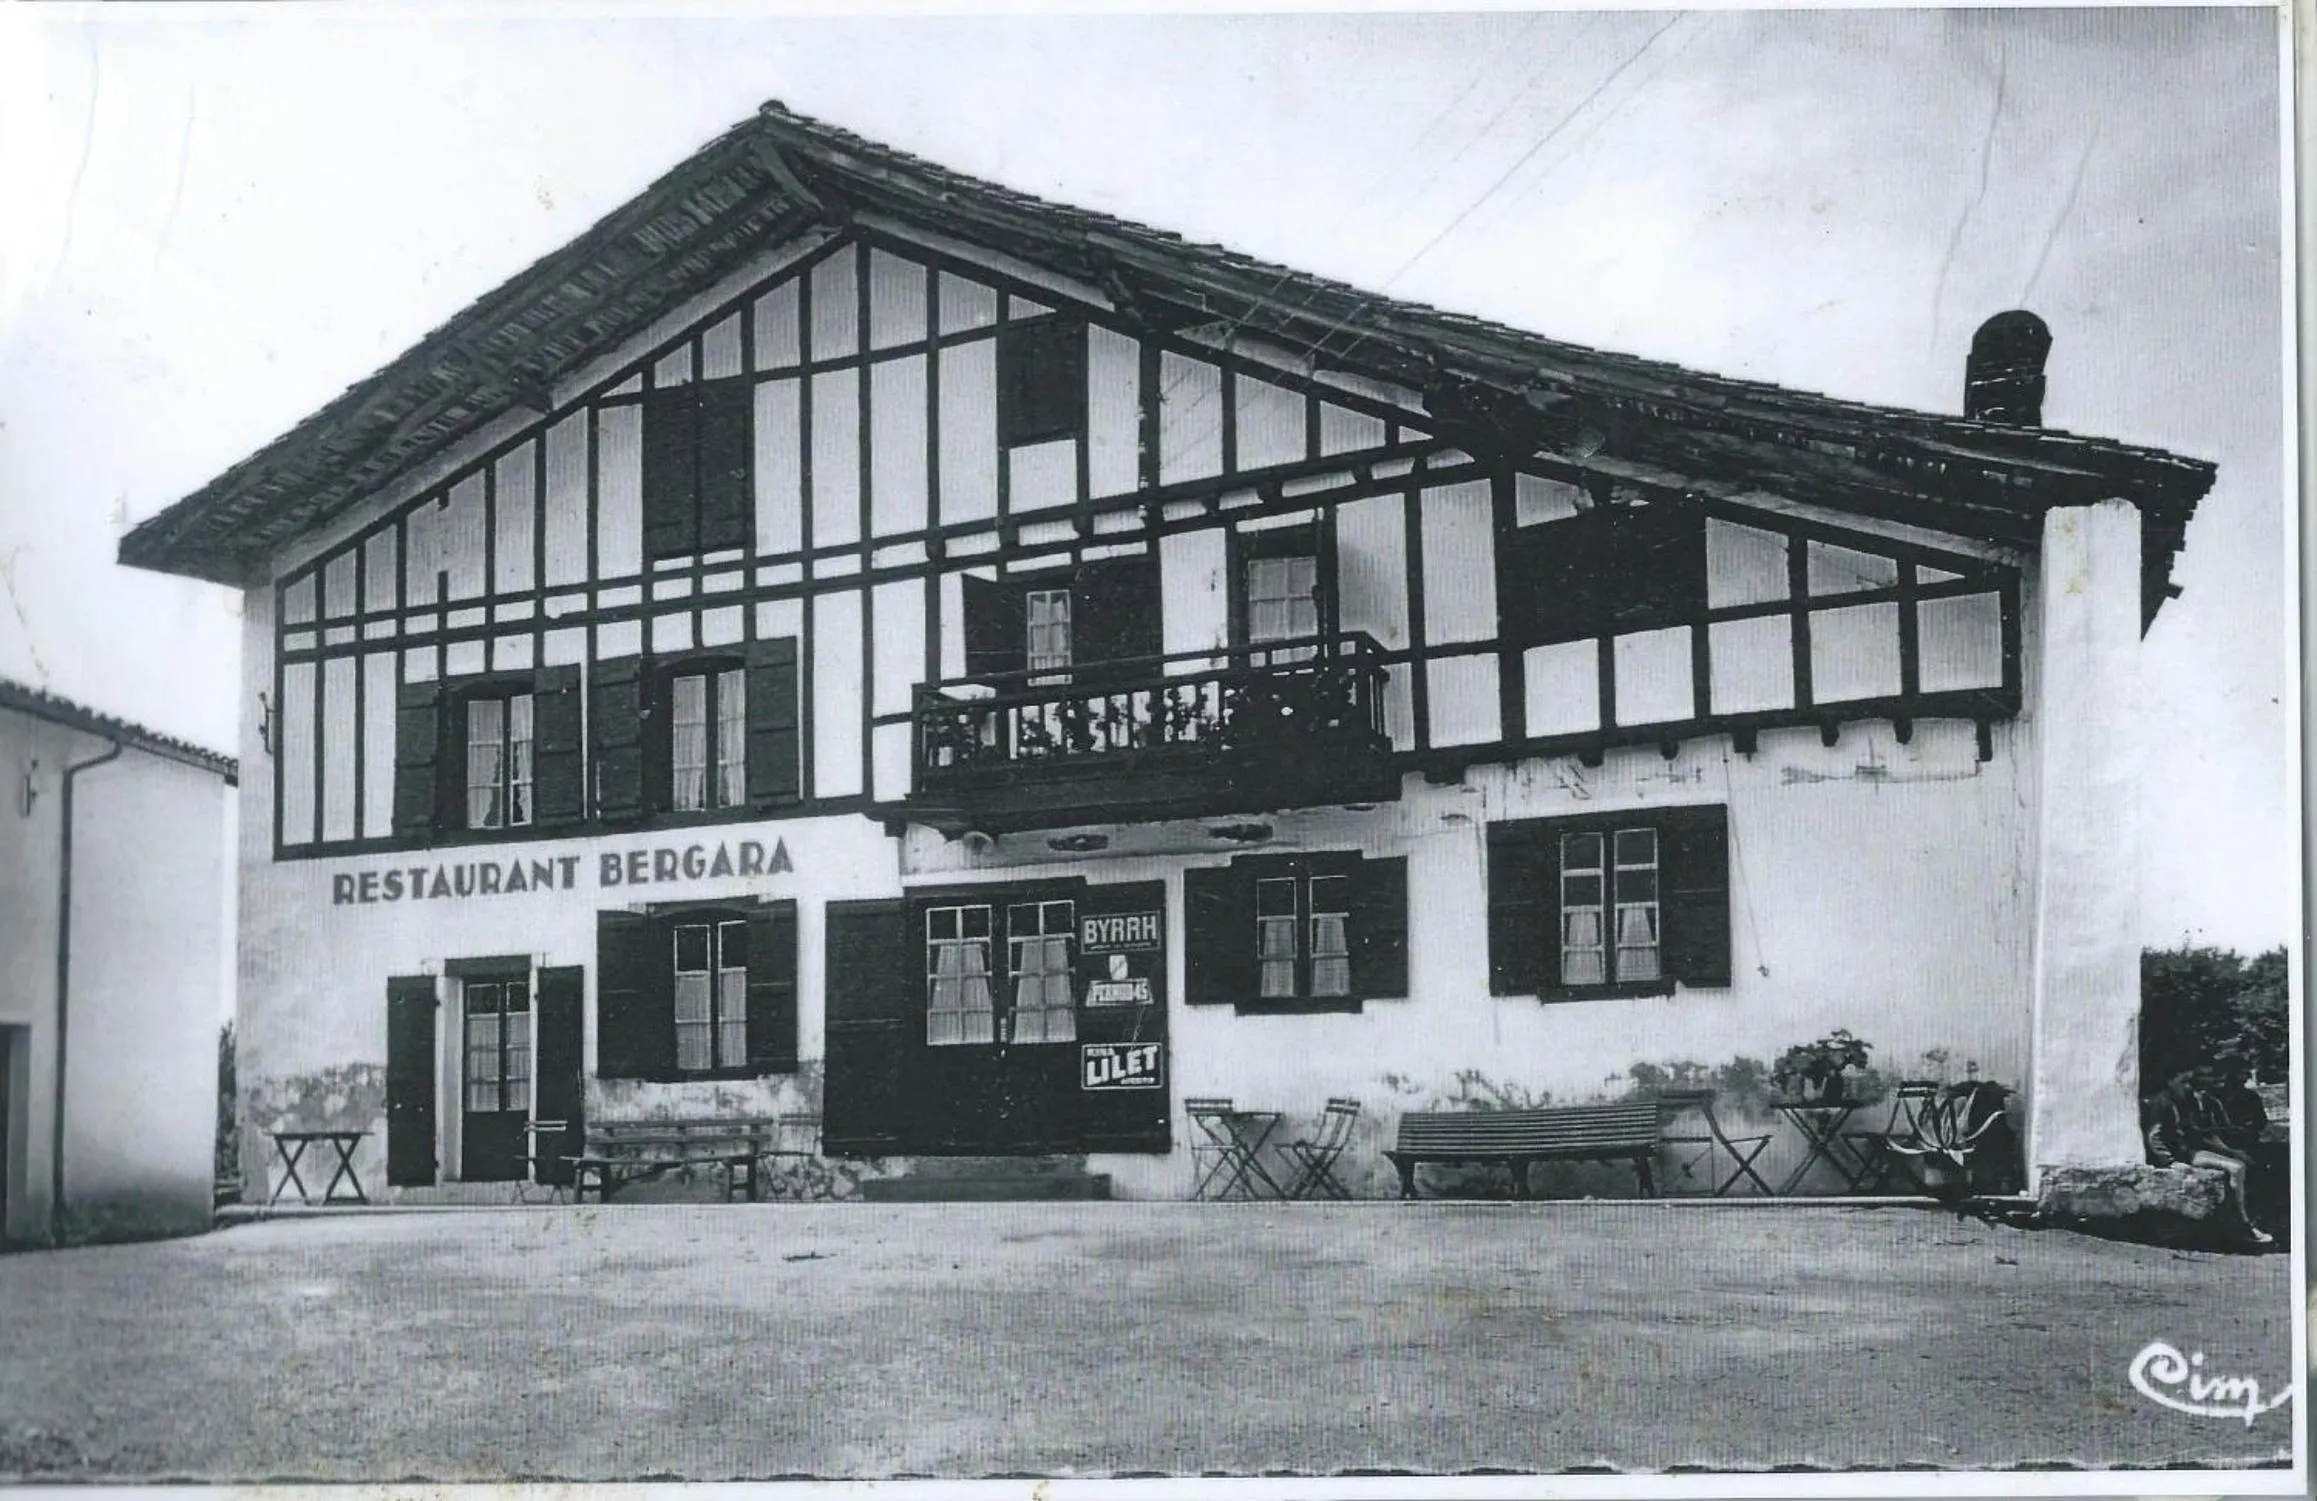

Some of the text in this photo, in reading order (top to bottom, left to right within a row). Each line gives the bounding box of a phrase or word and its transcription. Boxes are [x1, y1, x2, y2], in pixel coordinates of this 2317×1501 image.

[332, 836, 794, 906] RESTAURANT BERGARA
[1084, 915, 1157, 944] BYRRH
